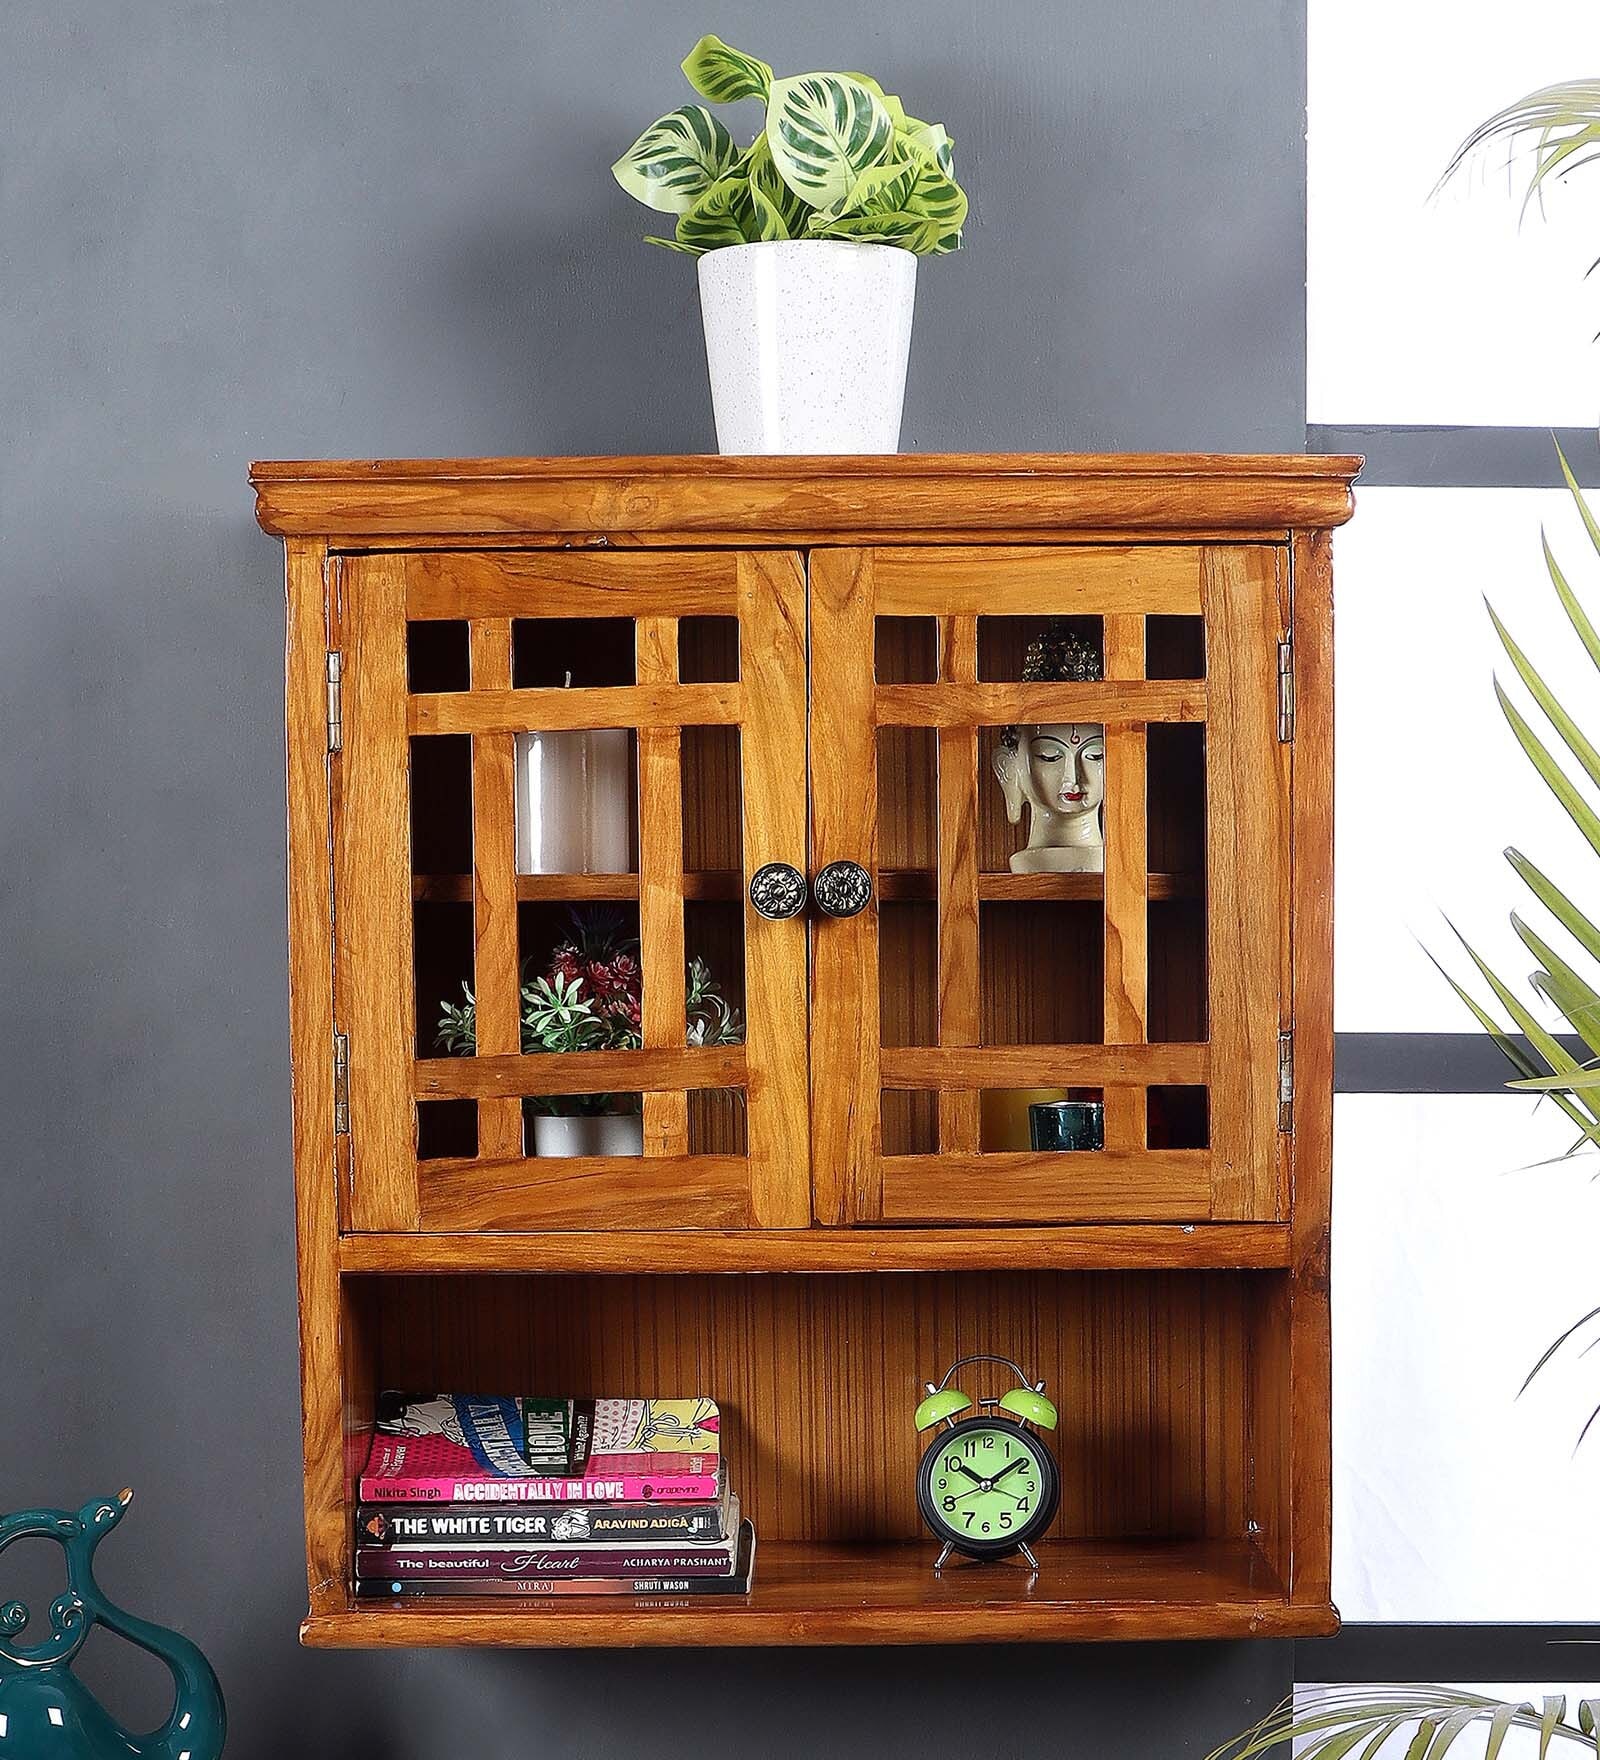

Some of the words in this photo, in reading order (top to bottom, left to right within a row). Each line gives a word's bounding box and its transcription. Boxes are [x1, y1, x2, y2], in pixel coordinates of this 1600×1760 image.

[527, 1411, 566, 1453] LOVE
[964, 1441, 976, 1457] 11
[983, 1437, 994, 1448] 12
[1004, 1441, 1010, 1458] 1
[944, 1456, 961, 1472] 10
[1018, 1458, 1029, 1474] 2
[453, 1483, 563, 1500] ACCIDENTALLY
[567, 1482, 582, 1499] IN
[586, 1482, 624, 1499] LOVE
[938, 1479, 947, 1489] 9
[1027, 1481, 1035, 1492] 3
[374, 1487, 406, 1497] Nikita
[410, 1487, 441, 1499] Singh
[943, 1496, 956, 1512] 8
[1017, 1496, 1029, 1513] 4
[392, 1518, 427, 1534] THE
[431, 1517, 491, 1534] WHITE
[493, 1516, 547, 1533] TIGER
[593, 1519, 649, 1530] ARAVIND
[650, 1517, 689, 1529] ADIGA
[962, 1512, 975, 1528] 7
[981, 1522, 990, 1533] 6
[1000, 1512, 1012, 1529] 5
[397, 1559, 424, 1568] The
[428, 1558, 490, 1568] beautiful
[500, 1553, 580, 1572] Heart
[623, 1558, 671, 1567] ACHARYA
[673, 1557, 729, 1567] PRASHANT
[516, 1582, 554, 1593] MIRAJ
[634, 1581, 662, 1590] SHRUTI
[663, 1581, 689, 1590] WASON
